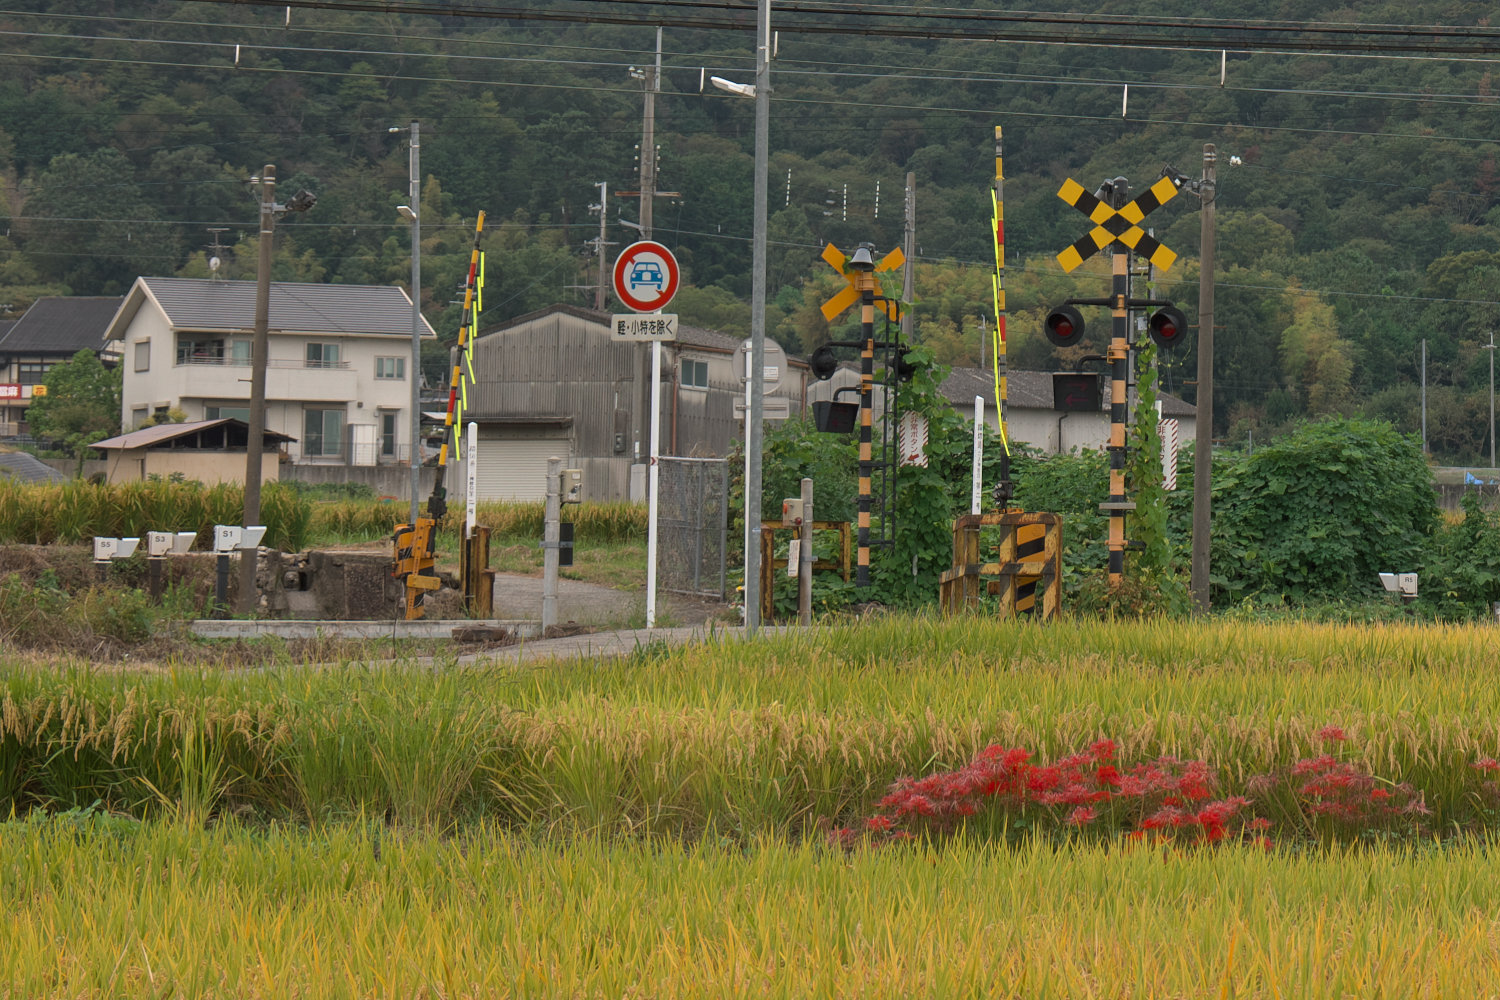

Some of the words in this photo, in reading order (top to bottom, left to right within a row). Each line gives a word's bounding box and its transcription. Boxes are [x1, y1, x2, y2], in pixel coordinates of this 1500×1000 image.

[617, 319, 673, 336] 軽・小特を除く
[155, 535, 166, 543] S3
